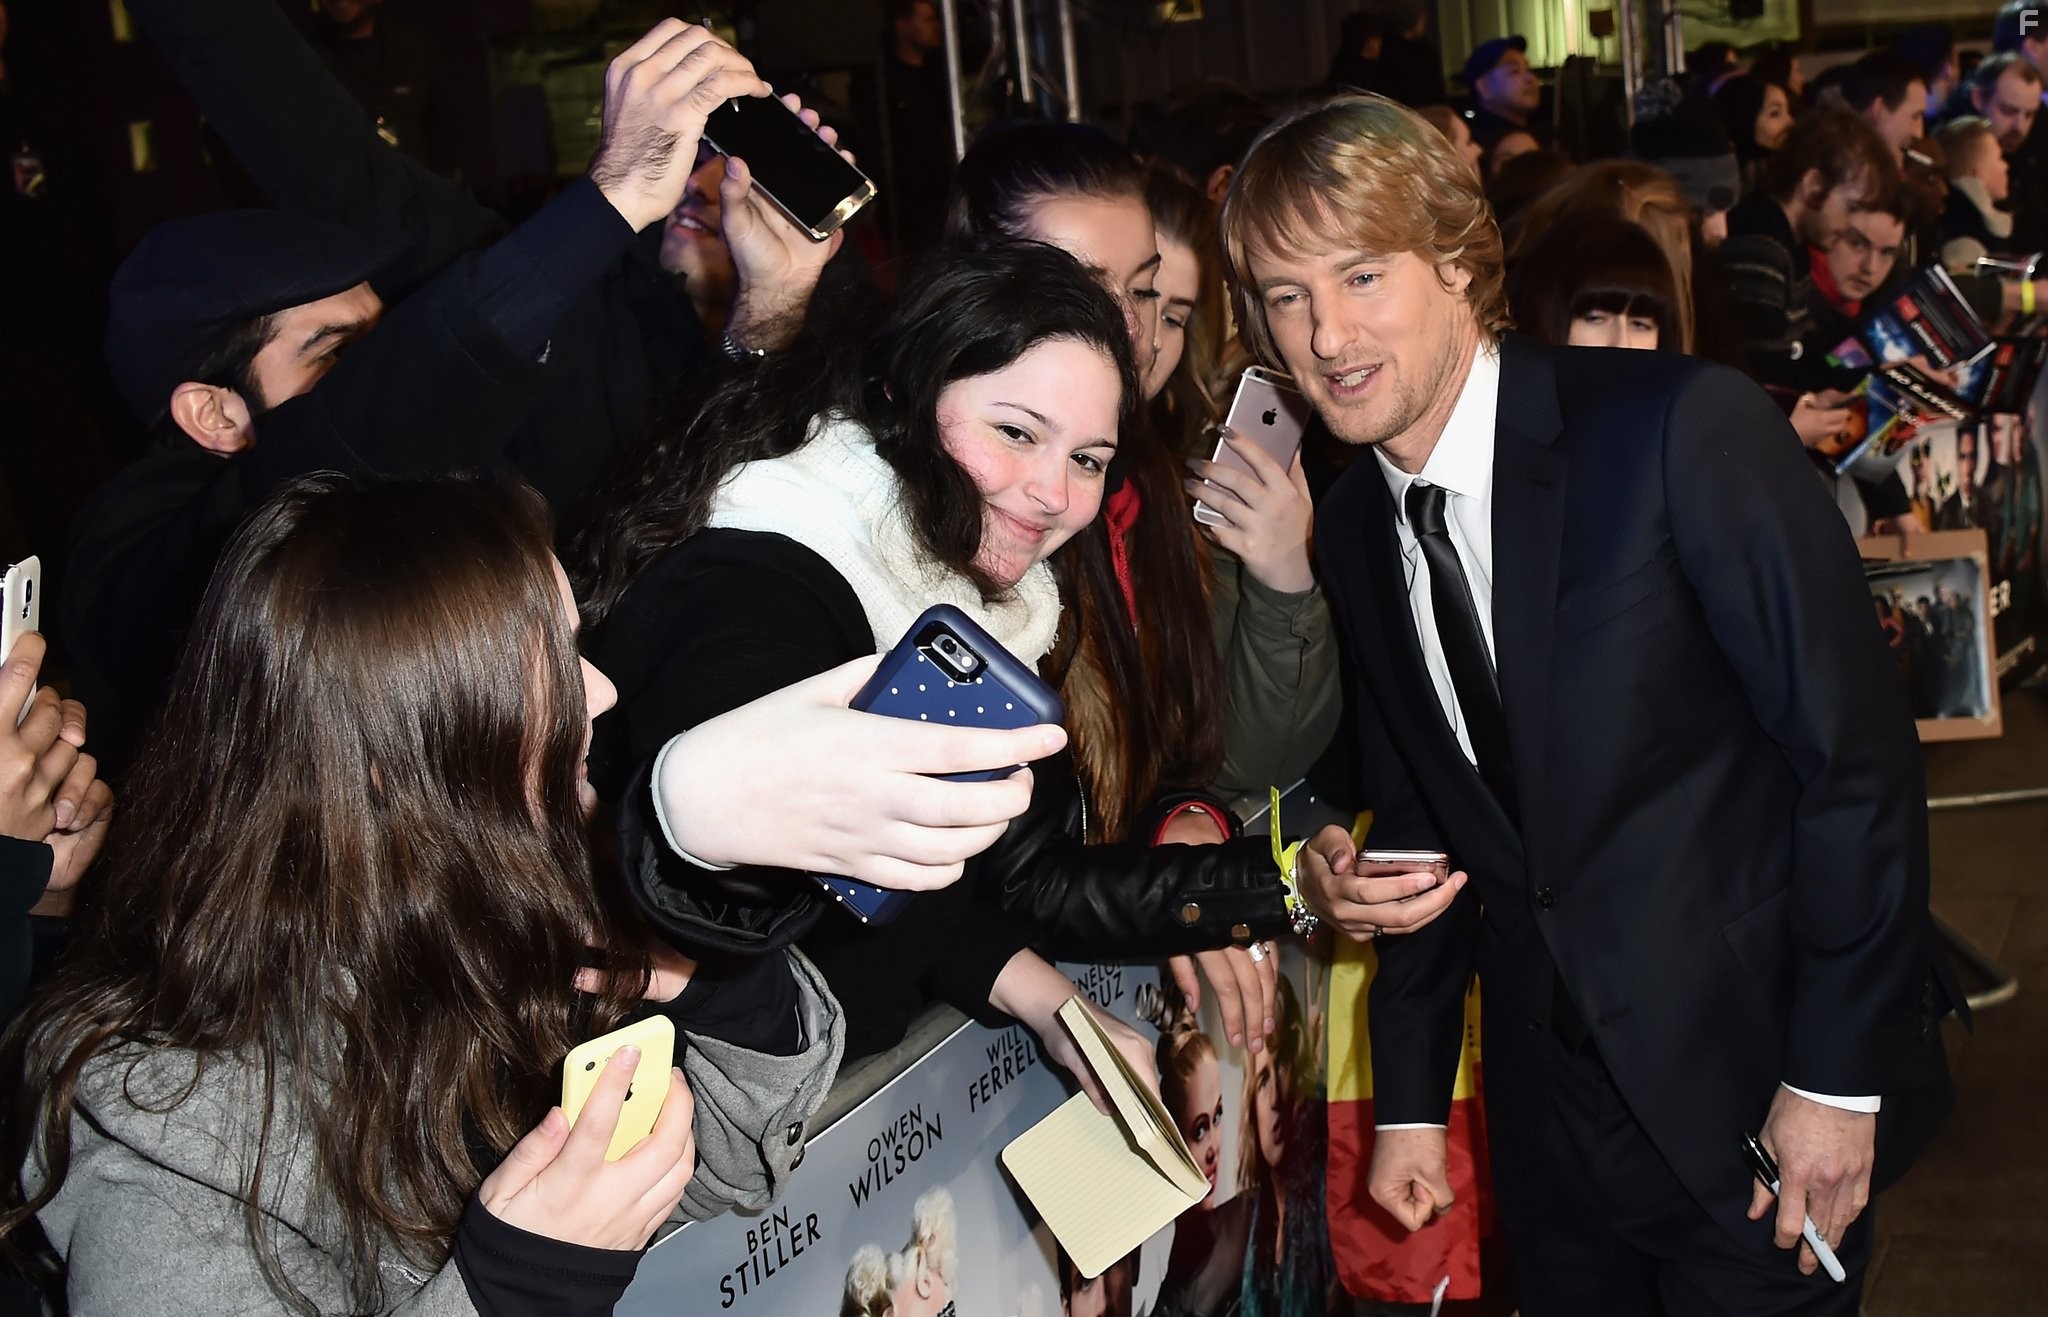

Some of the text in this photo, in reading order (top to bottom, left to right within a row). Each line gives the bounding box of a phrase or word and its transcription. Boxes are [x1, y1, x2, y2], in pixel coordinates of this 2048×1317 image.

[969, 1039, 1040, 1113] FERREL
[986, 1025, 1021, 1065] WILL
[849, 1112, 943, 1209] WILSON
[867, 1103, 922, 1162] OWEN
[719, 1212, 822, 1309] STILLER
[746, 1205, 789, 1255] BEN
